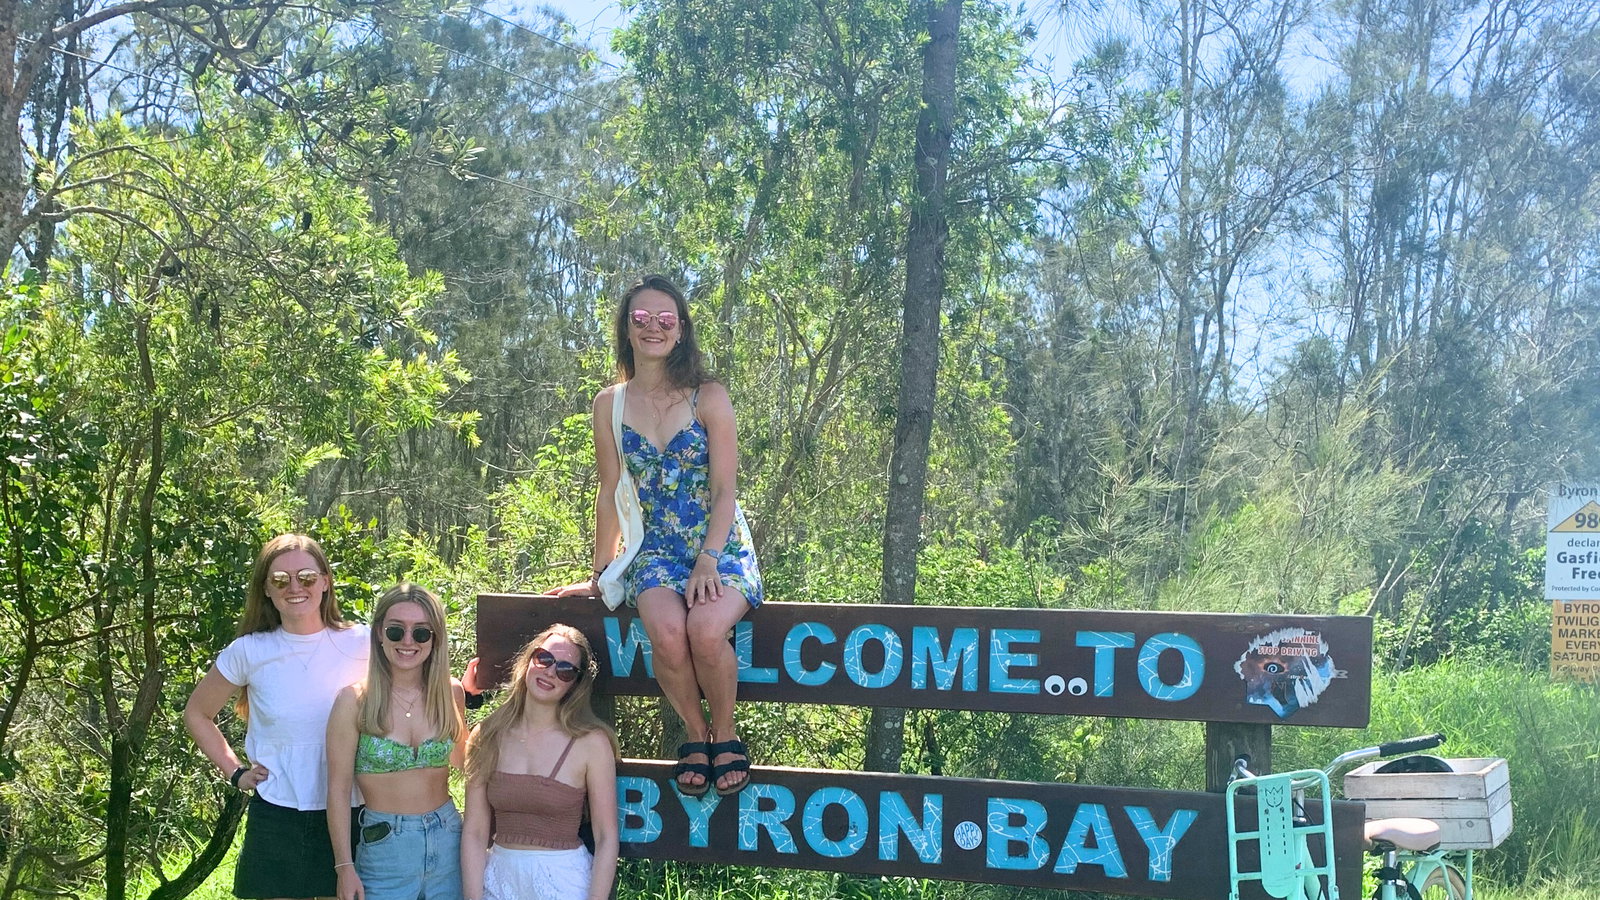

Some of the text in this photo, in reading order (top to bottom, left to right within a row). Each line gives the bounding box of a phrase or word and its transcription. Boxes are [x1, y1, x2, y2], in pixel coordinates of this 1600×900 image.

[1559, 484, 1598, 499] Byron
[1575, 512, 1600, 528] 98
[1557, 551, 1600, 564] Gasfi
[603, 617, 1205, 701] WLCOME TO
[1258, 646, 1318, 657] STOP DRIVING
[616, 775, 1200, 882] BYRON BAY
[955, 823, 980, 839] HAPPY
[959, 836, 979, 849] DAYS
